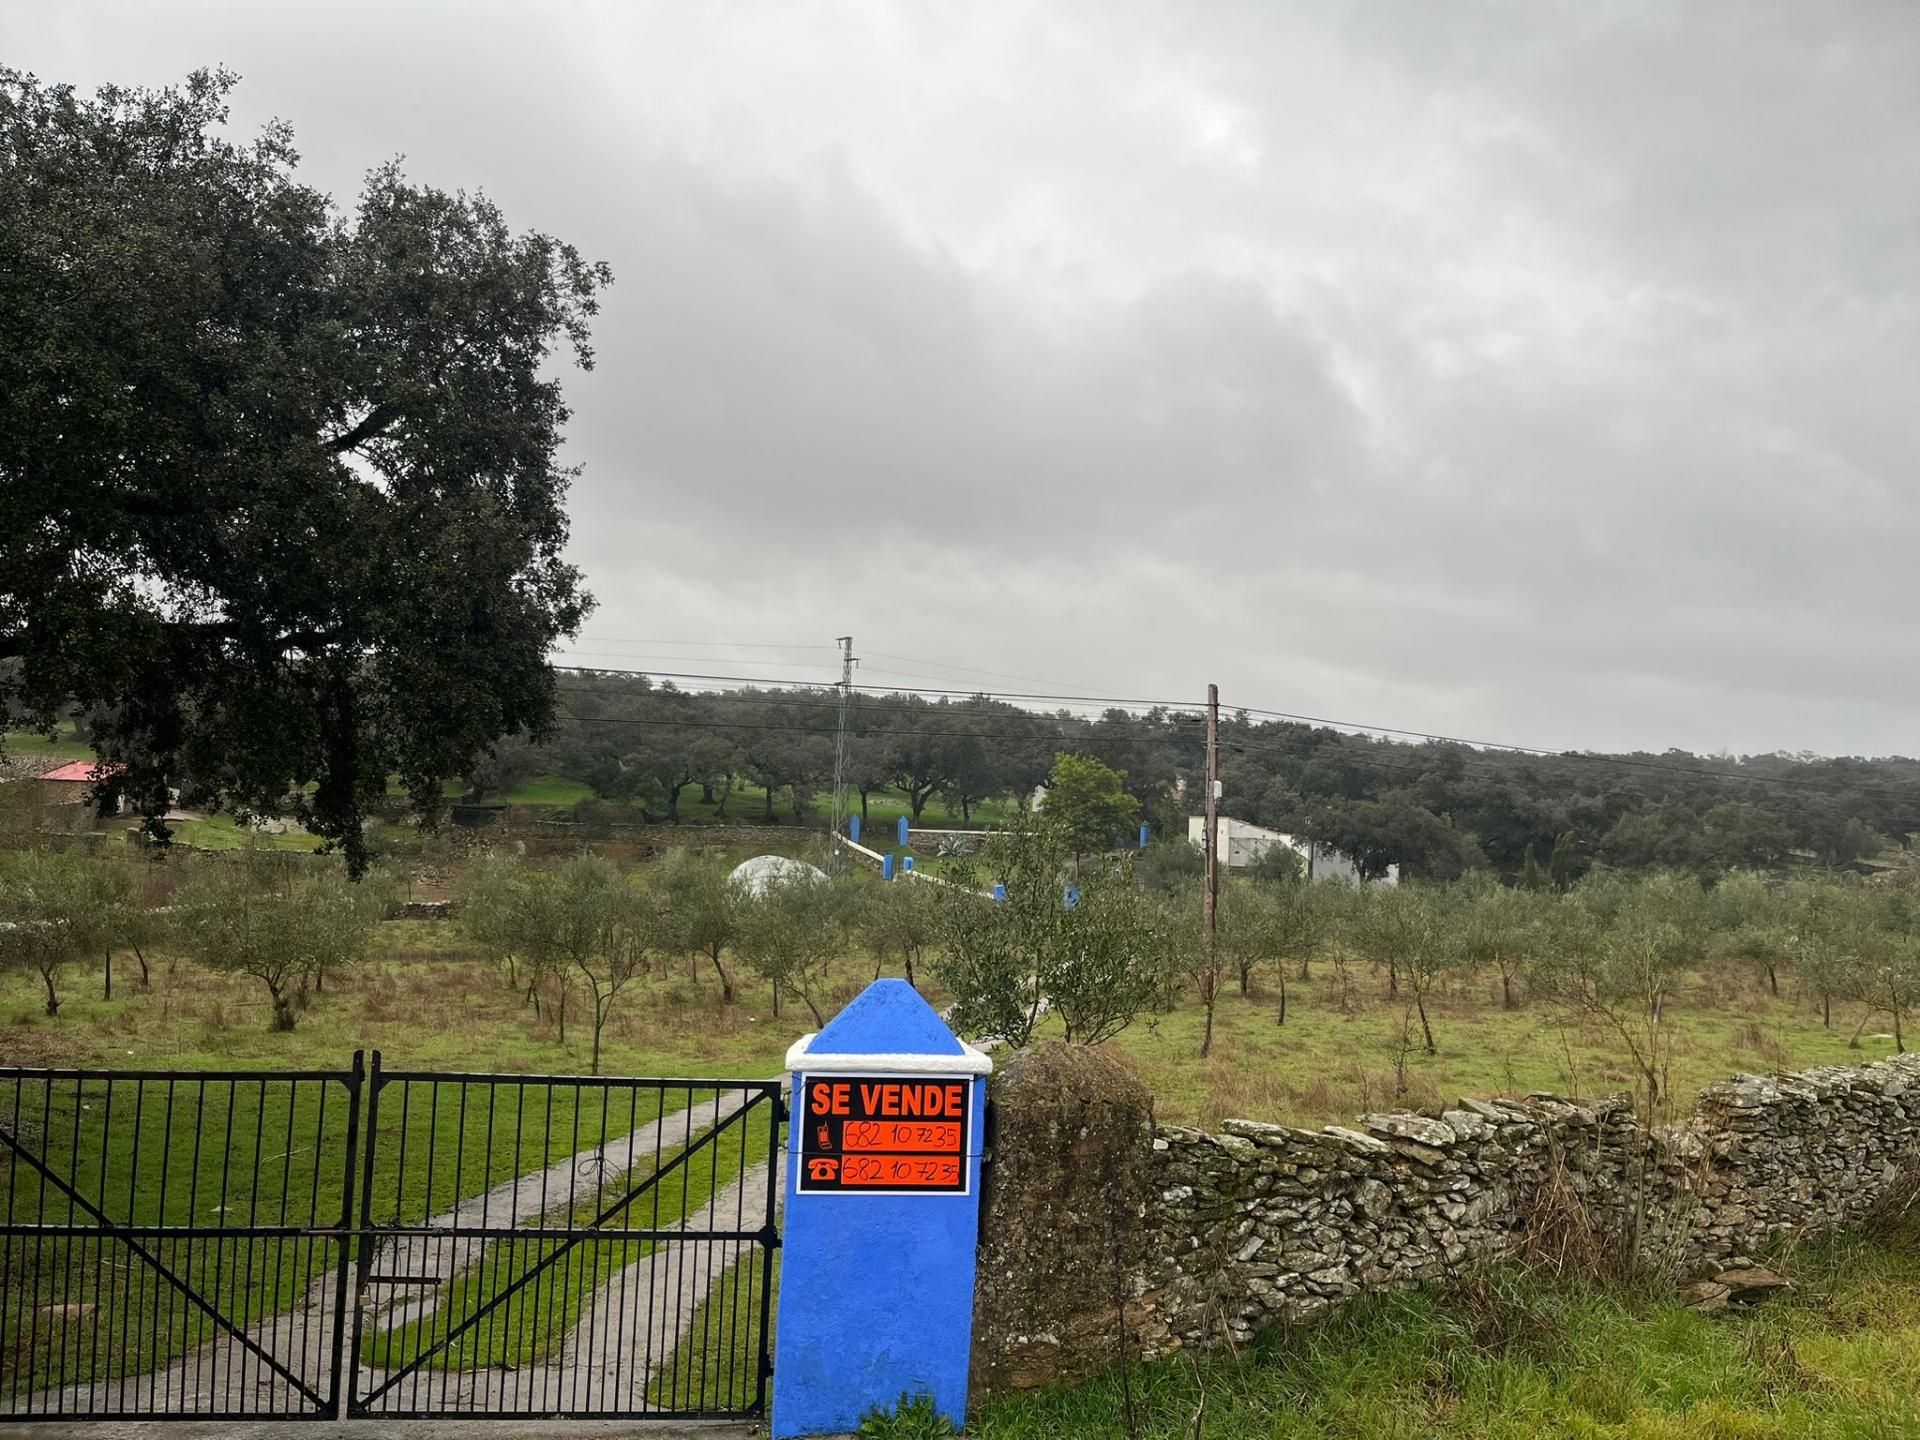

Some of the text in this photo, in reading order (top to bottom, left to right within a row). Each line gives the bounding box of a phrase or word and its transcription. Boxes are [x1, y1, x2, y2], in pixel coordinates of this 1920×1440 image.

[811, 1083, 963, 1117] SE VENDE
[845, 1121, 882, 1148] 682
[891, 1124, 912, 1144] 10
[843, 1157, 884, 1181] 682
[891, 1160, 912, 1179] 10
